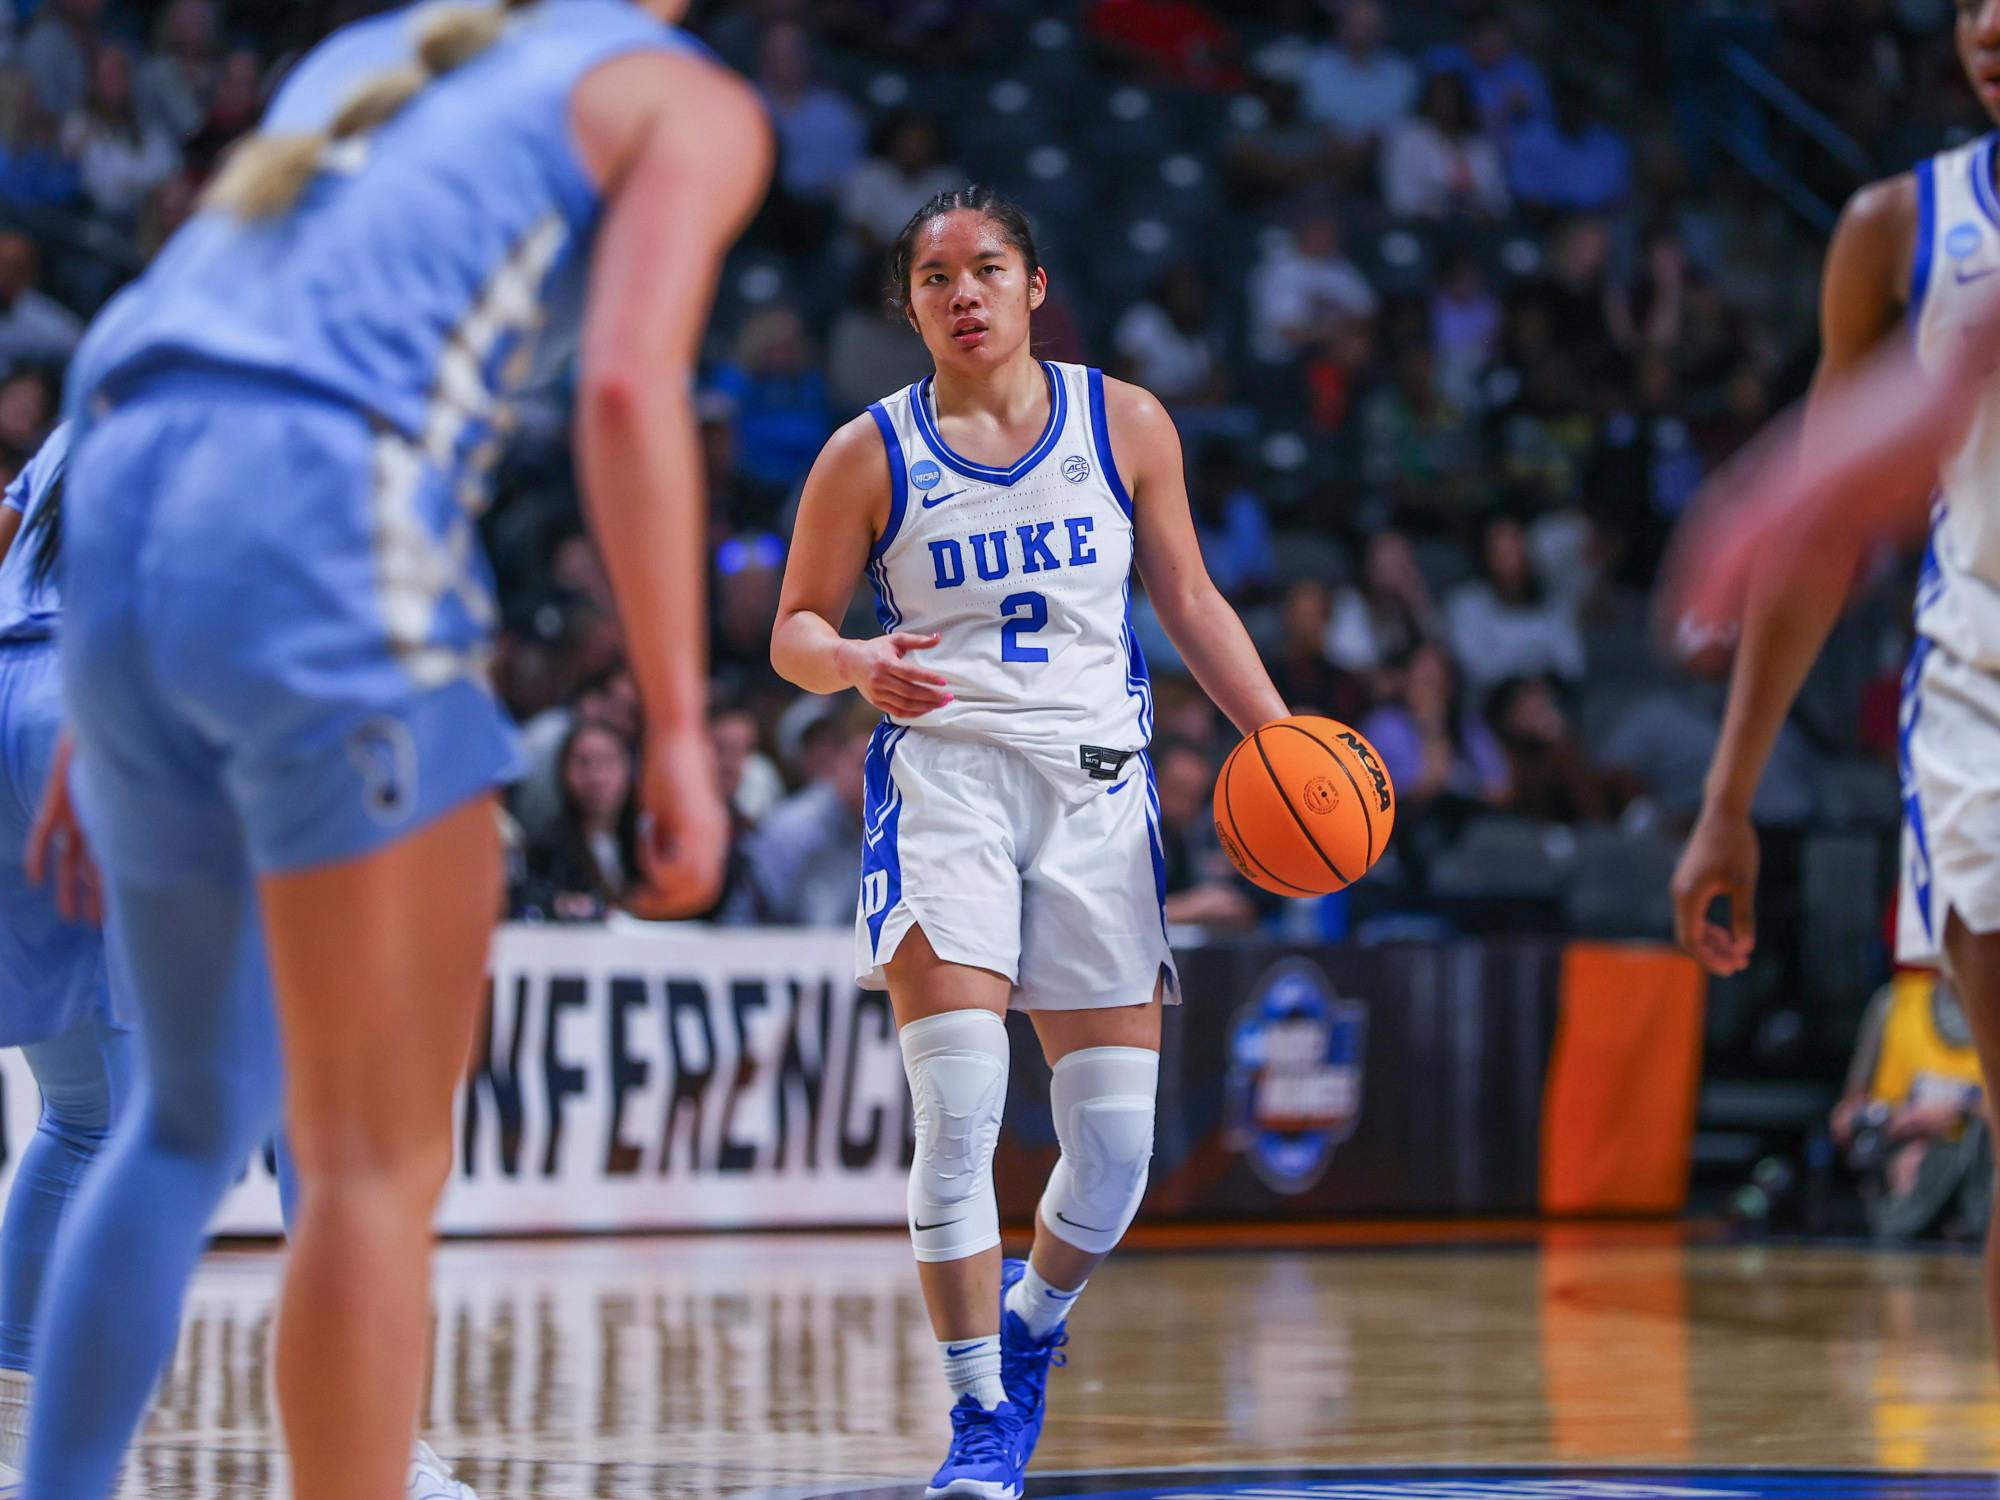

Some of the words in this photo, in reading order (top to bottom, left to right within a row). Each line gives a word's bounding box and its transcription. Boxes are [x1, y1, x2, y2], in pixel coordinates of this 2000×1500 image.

[928, 516, 1097, 589] DUKE
[1000, 591, 1049, 663] 2
[1335, 731, 1391, 813] NCAA
[461, 976, 912, 1178] NFERENC
